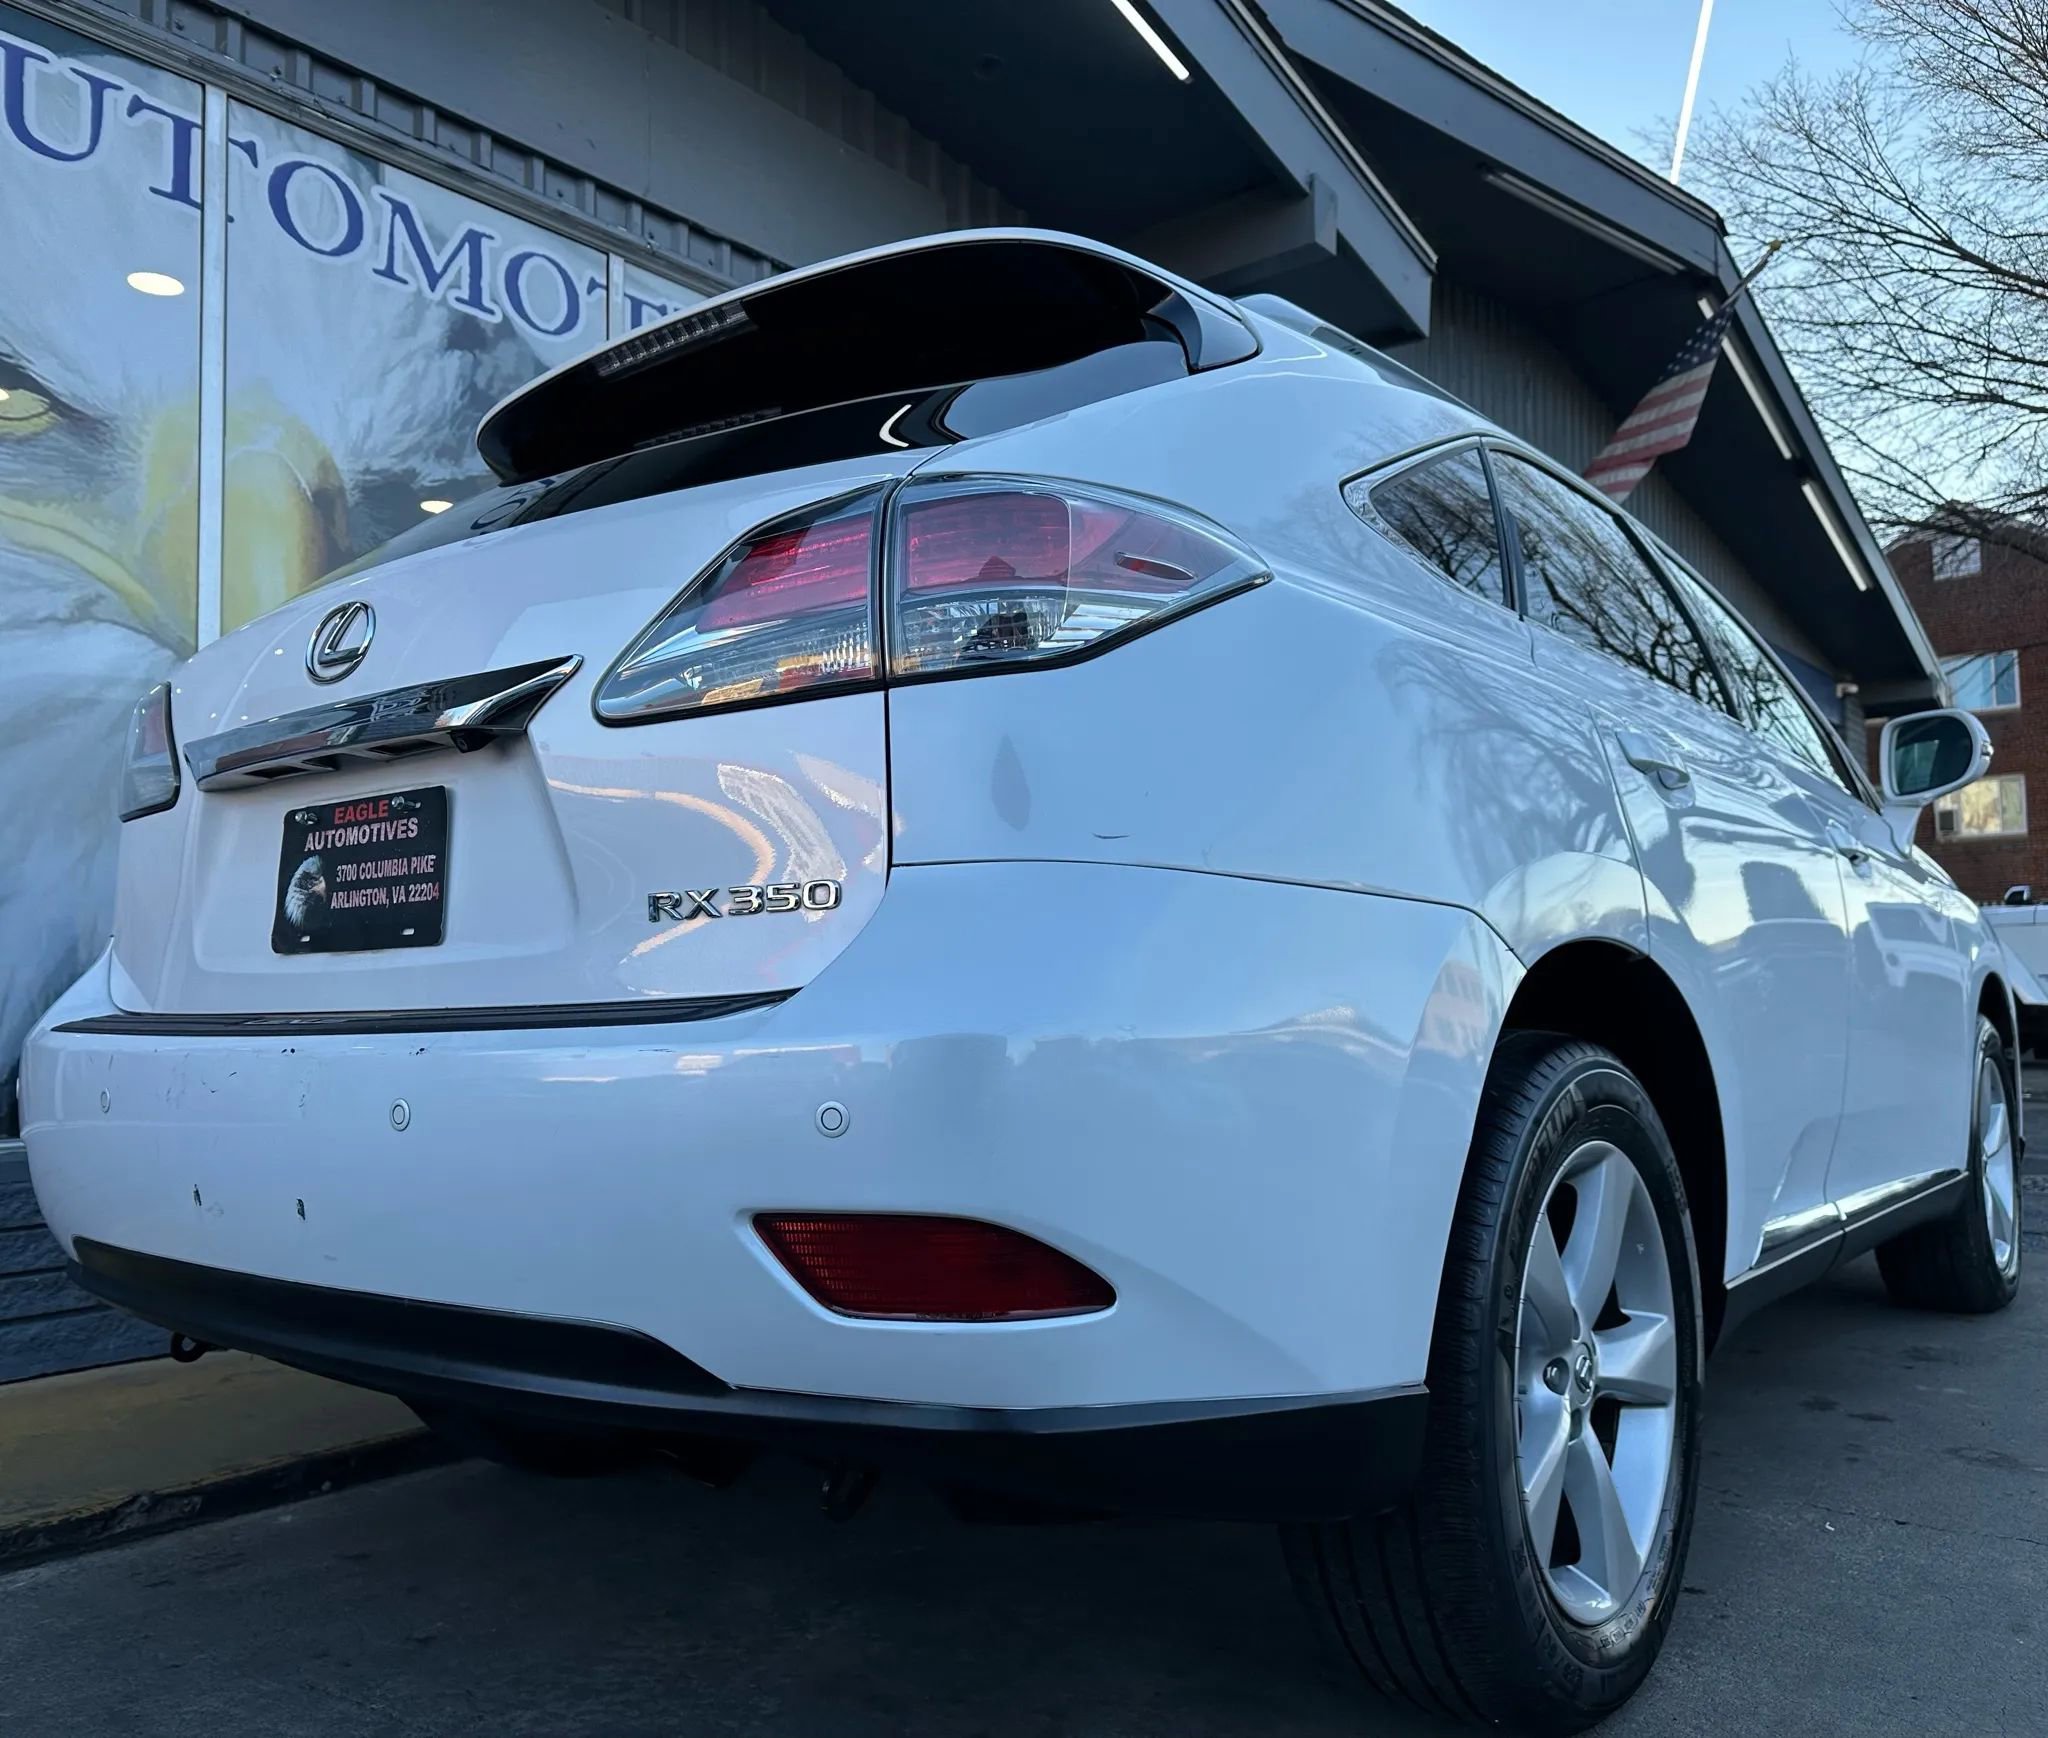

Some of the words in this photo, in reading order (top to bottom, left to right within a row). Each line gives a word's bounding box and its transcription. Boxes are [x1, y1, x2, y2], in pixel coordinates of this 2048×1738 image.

[333, 800, 389, 824] EAGLE
[304, 817, 418, 851] AUTOMOTIVES
[336, 863, 357, 883] 3700
[359, 857, 408, 880] COLUMBIA
[411, 854, 436, 874] PIKE
[330, 887, 390, 909] ARLINGTON,
[392, 886, 406, 904] VA
[408, 882, 439, 902] 22204
[648, 888, 723, 922] RX
[728, 879, 842, 916] 350
